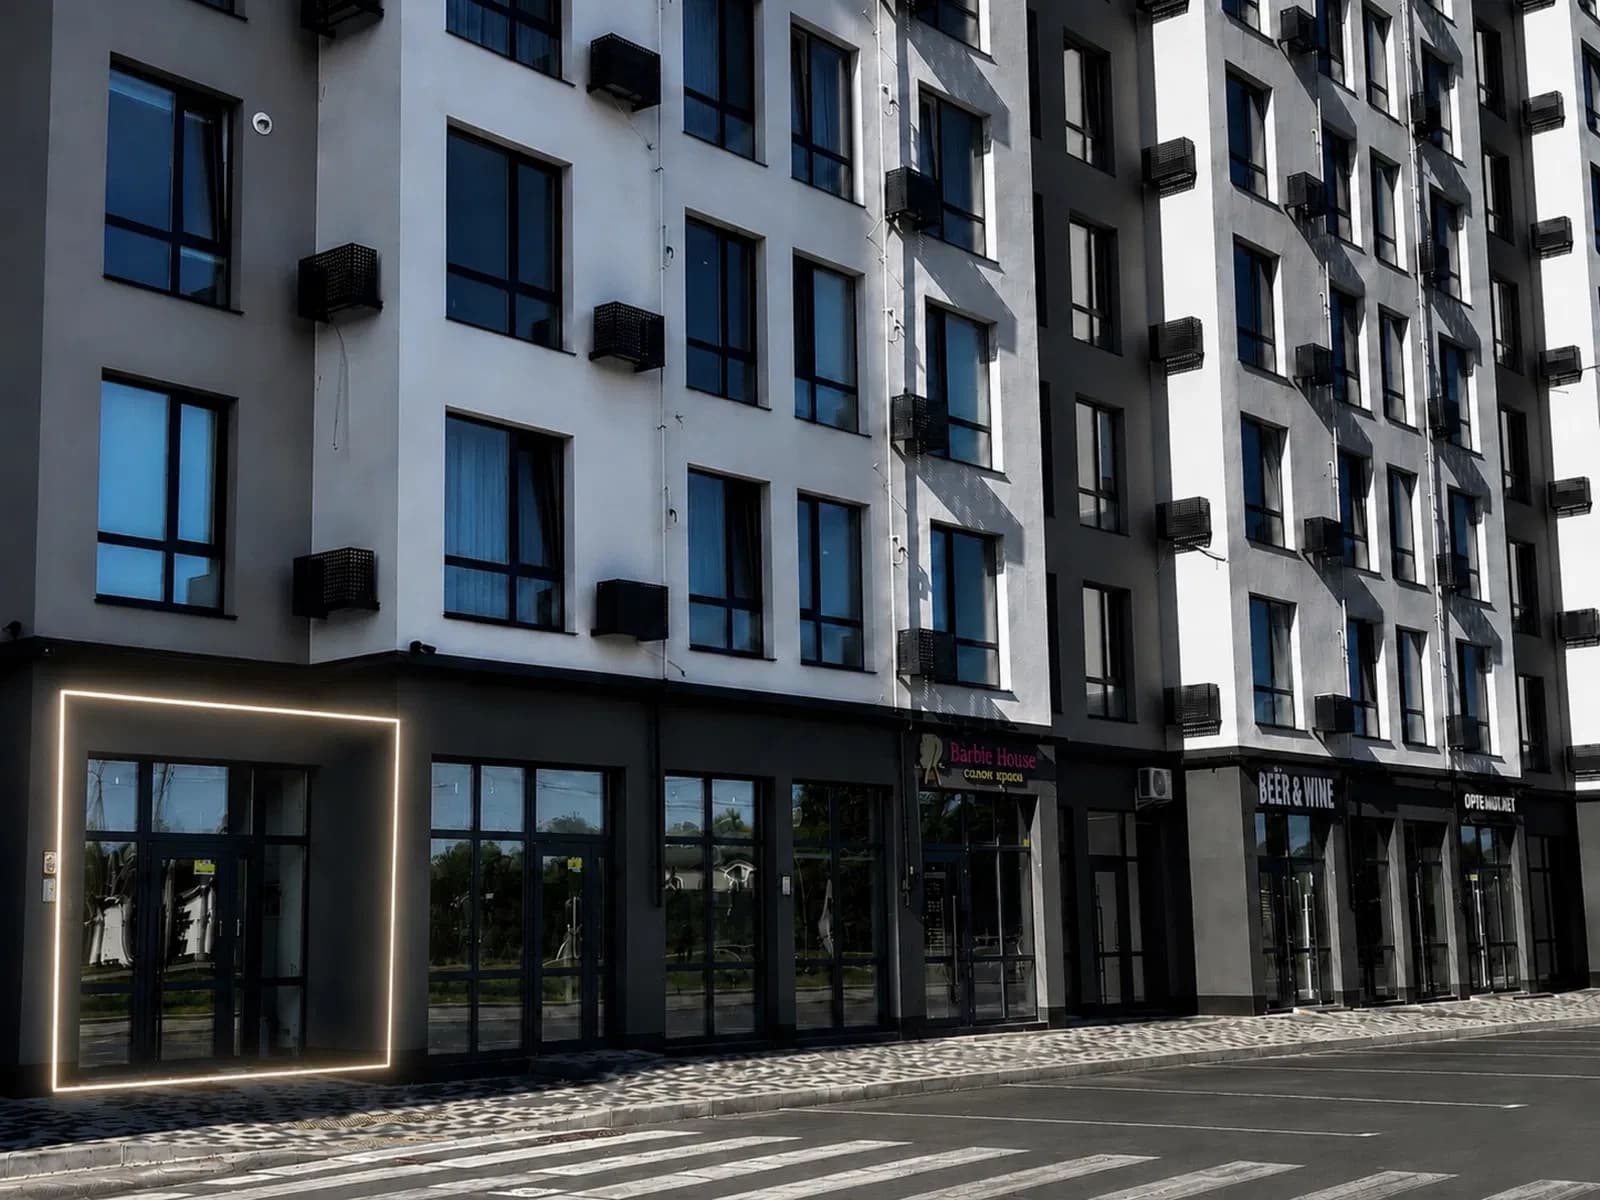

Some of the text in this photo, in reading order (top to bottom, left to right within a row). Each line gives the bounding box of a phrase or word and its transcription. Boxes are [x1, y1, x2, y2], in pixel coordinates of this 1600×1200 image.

[950, 742, 1036, 769] Barbie House
[1303, 776, 1335, 809] WINE
